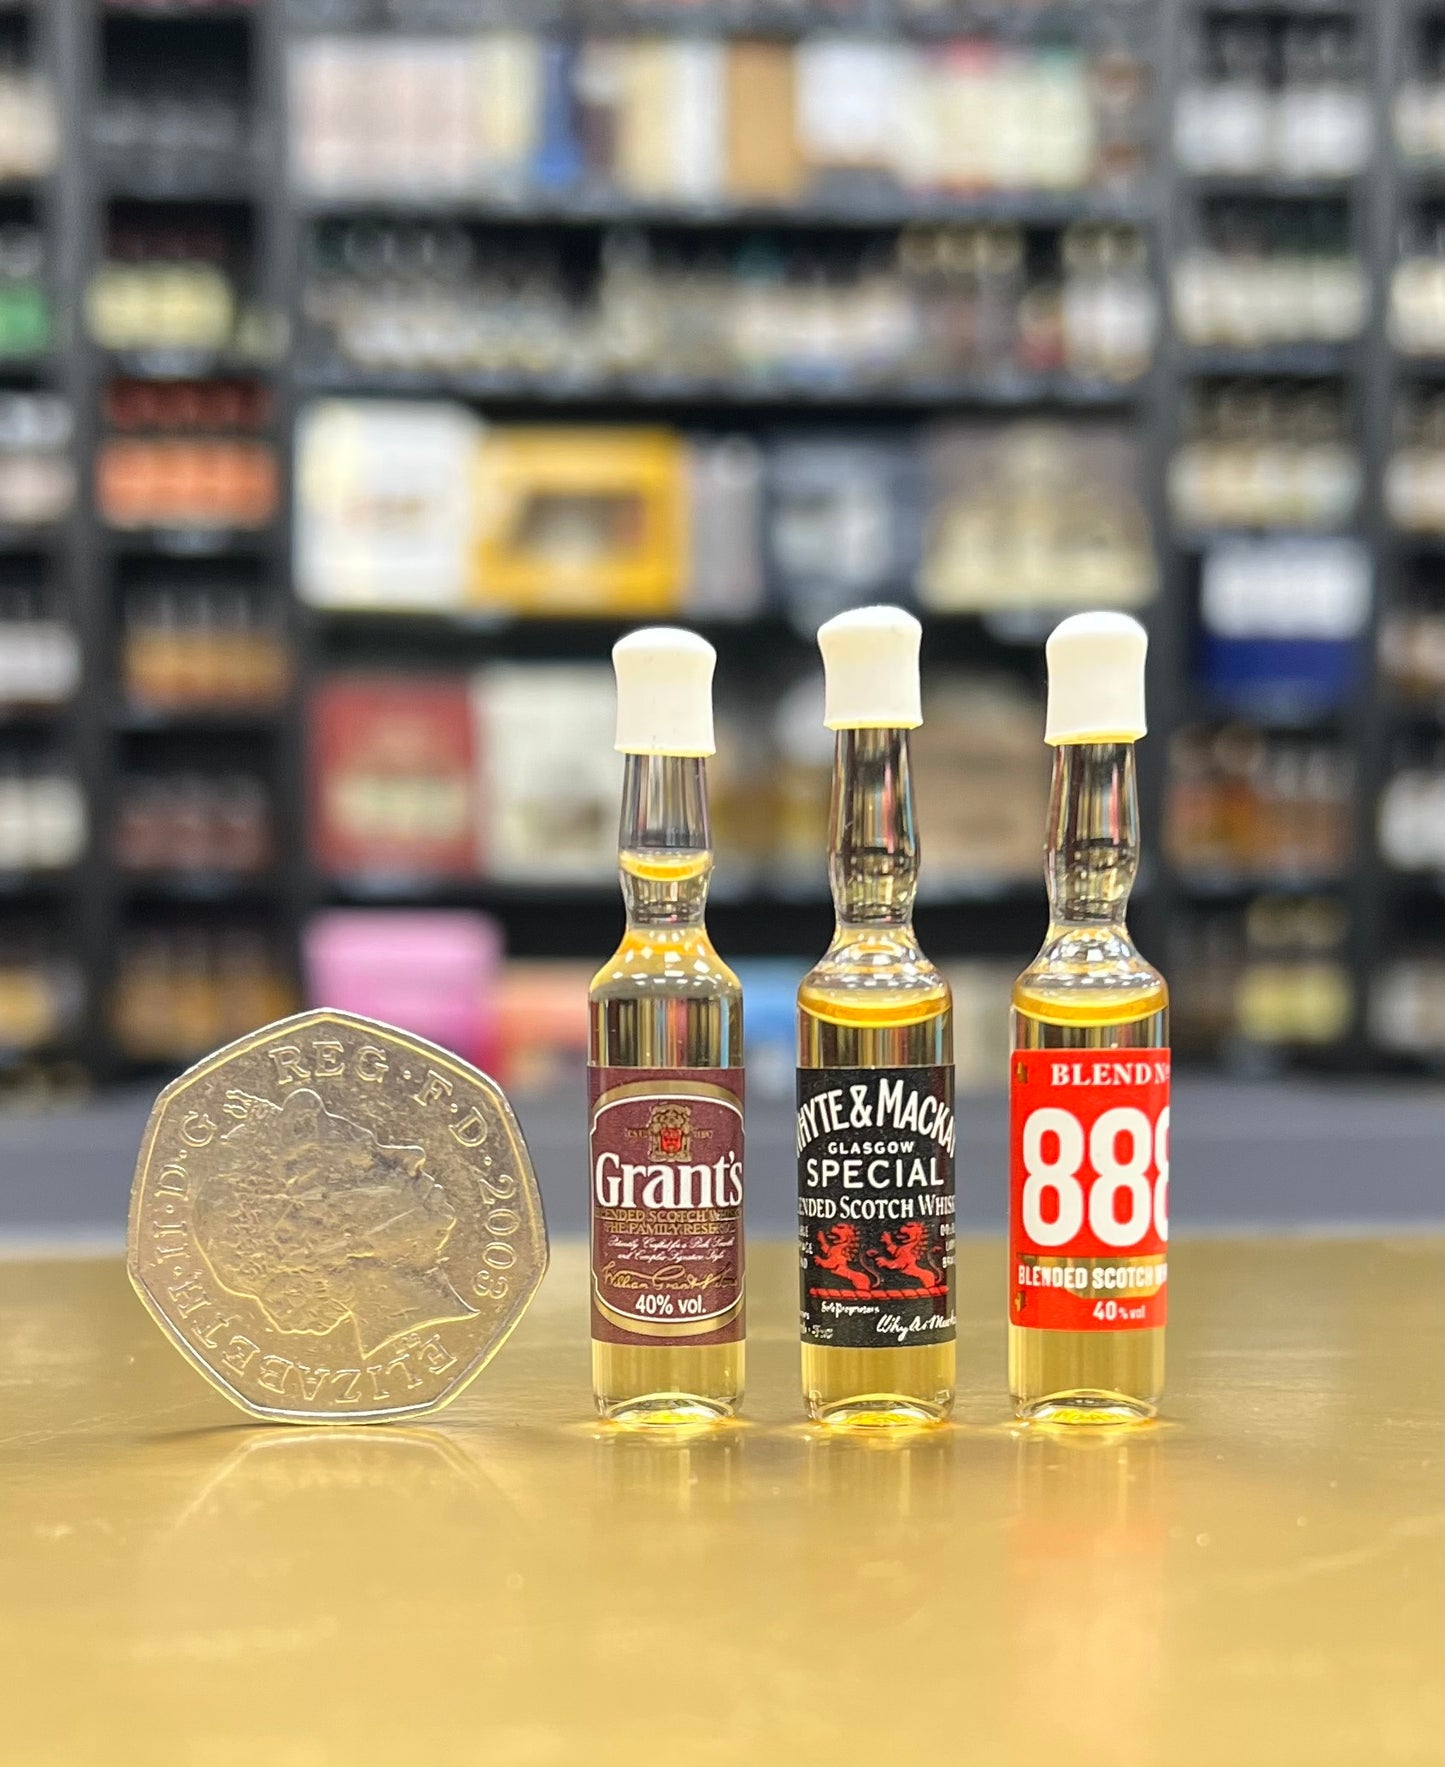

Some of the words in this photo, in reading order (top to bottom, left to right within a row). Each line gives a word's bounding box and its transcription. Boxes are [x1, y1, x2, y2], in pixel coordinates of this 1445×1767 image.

[1051, 1063, 1152, 1086] BLEND
[850, 1085, 872, 1128] &
[828, 1141, 915, 1155] GLASGOW
[595, 1151, 743, 1209] Grant's
[807, 1157, 945, 1189] SPECIAL
[629, 1222, 682, 1236] FAMILY
[1018, 1265, 1088, 1290] BLENDED
[1092, 1265, 1154, 1290] SCOTCH
[634, 1294, 674, 1316] 40%
[677, 1294, 707, 1315] vol.
